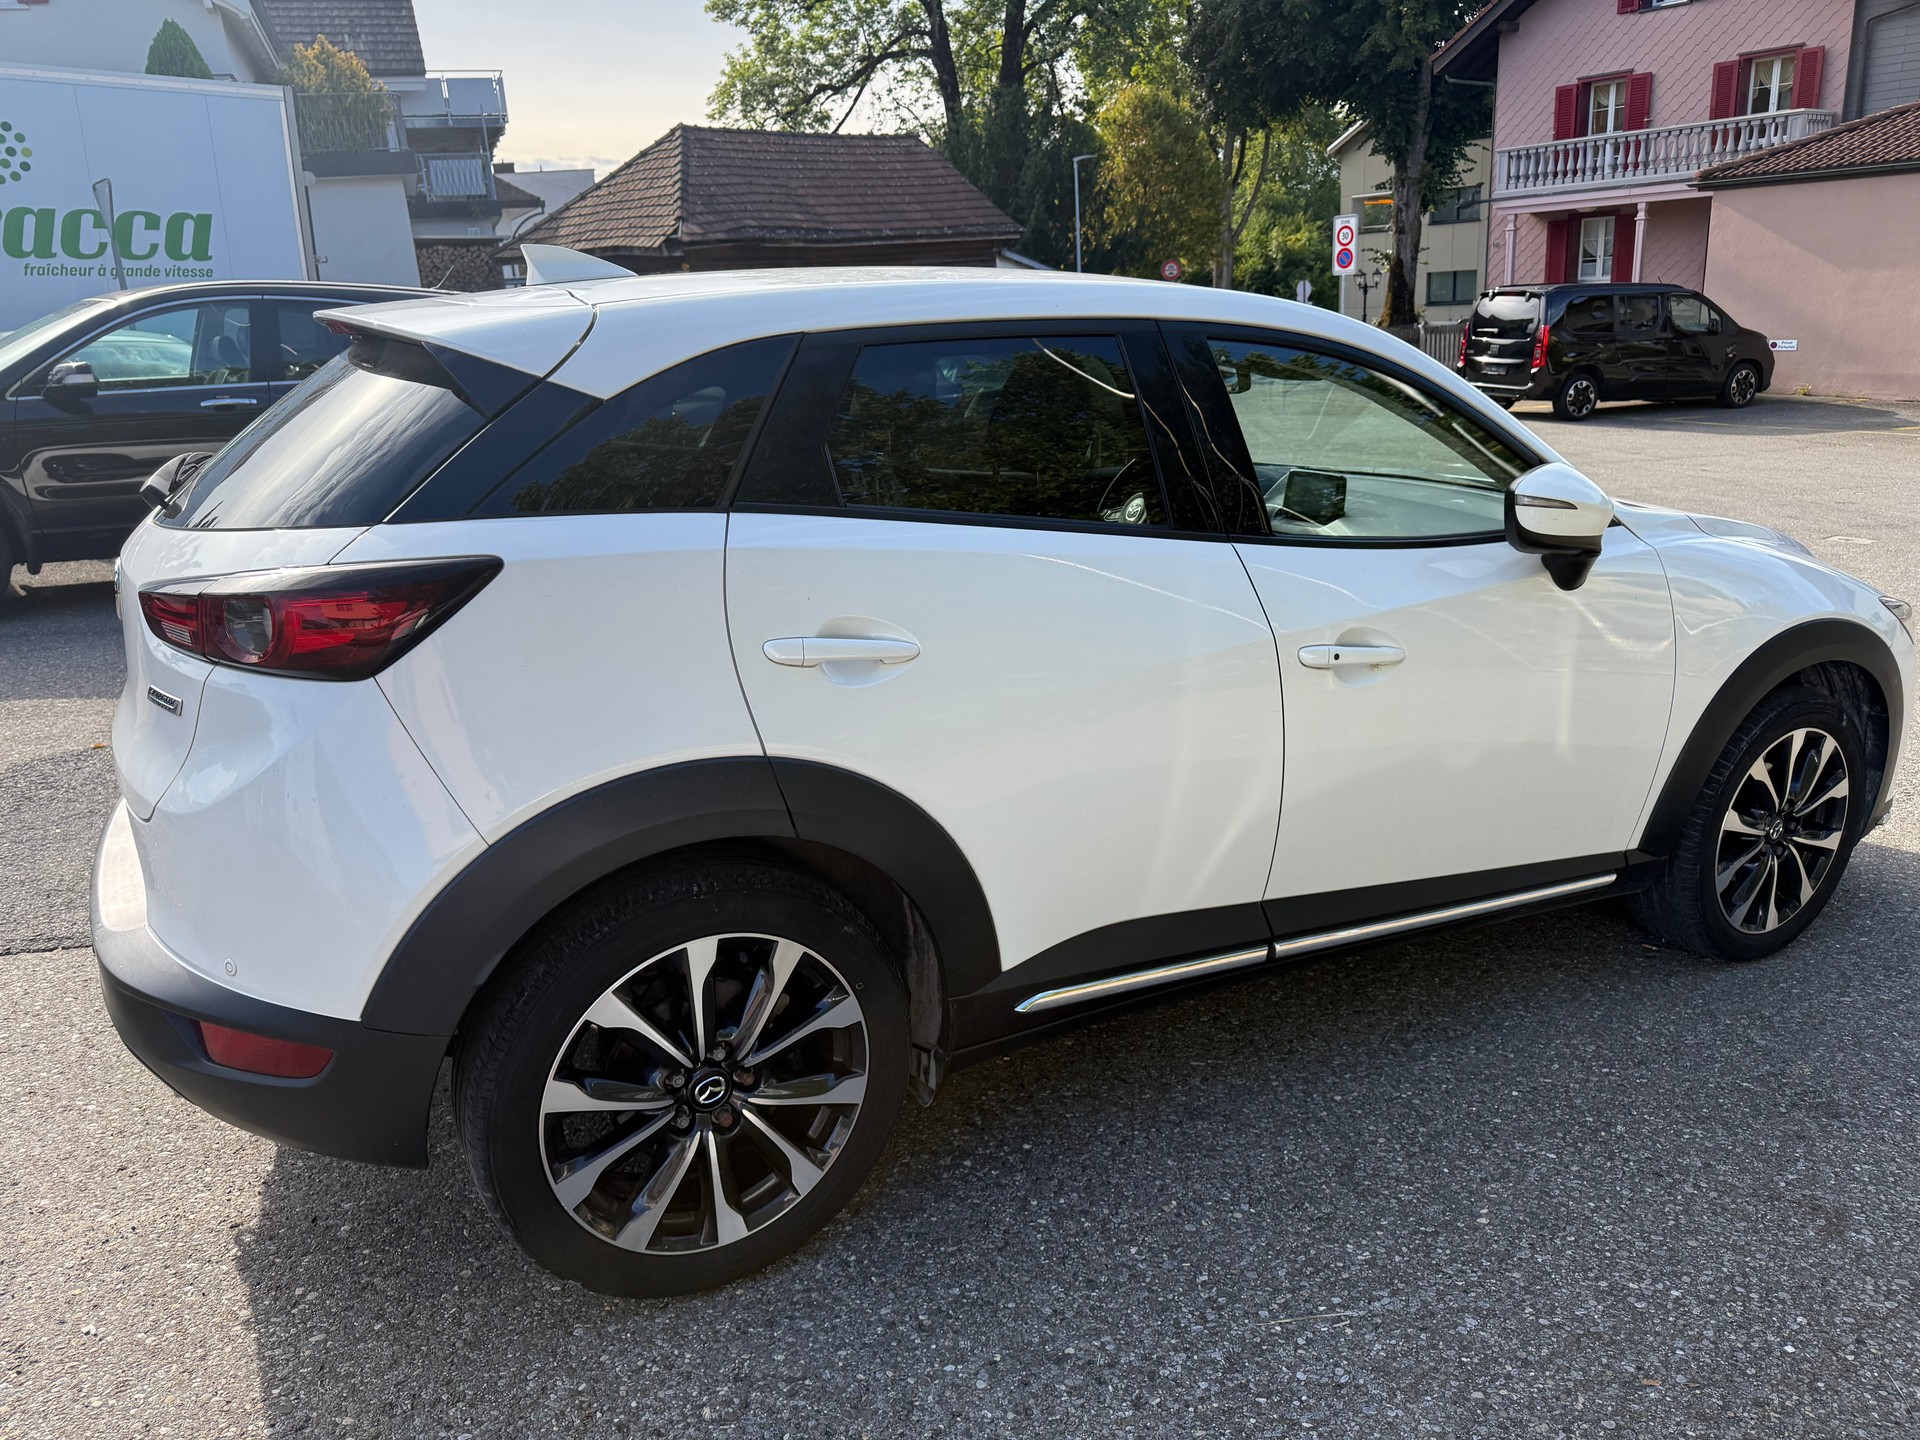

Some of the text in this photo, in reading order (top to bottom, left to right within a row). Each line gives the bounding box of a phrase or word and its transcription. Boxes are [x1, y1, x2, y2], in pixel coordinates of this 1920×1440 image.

[0, 206, 213, 261] acca
[1341, 231, 1350, 241] 30
[23, 263, 94, 277] fraîcheur
[97, 263, 106, 277] à
[164, 264, 214, 278] vitesse
